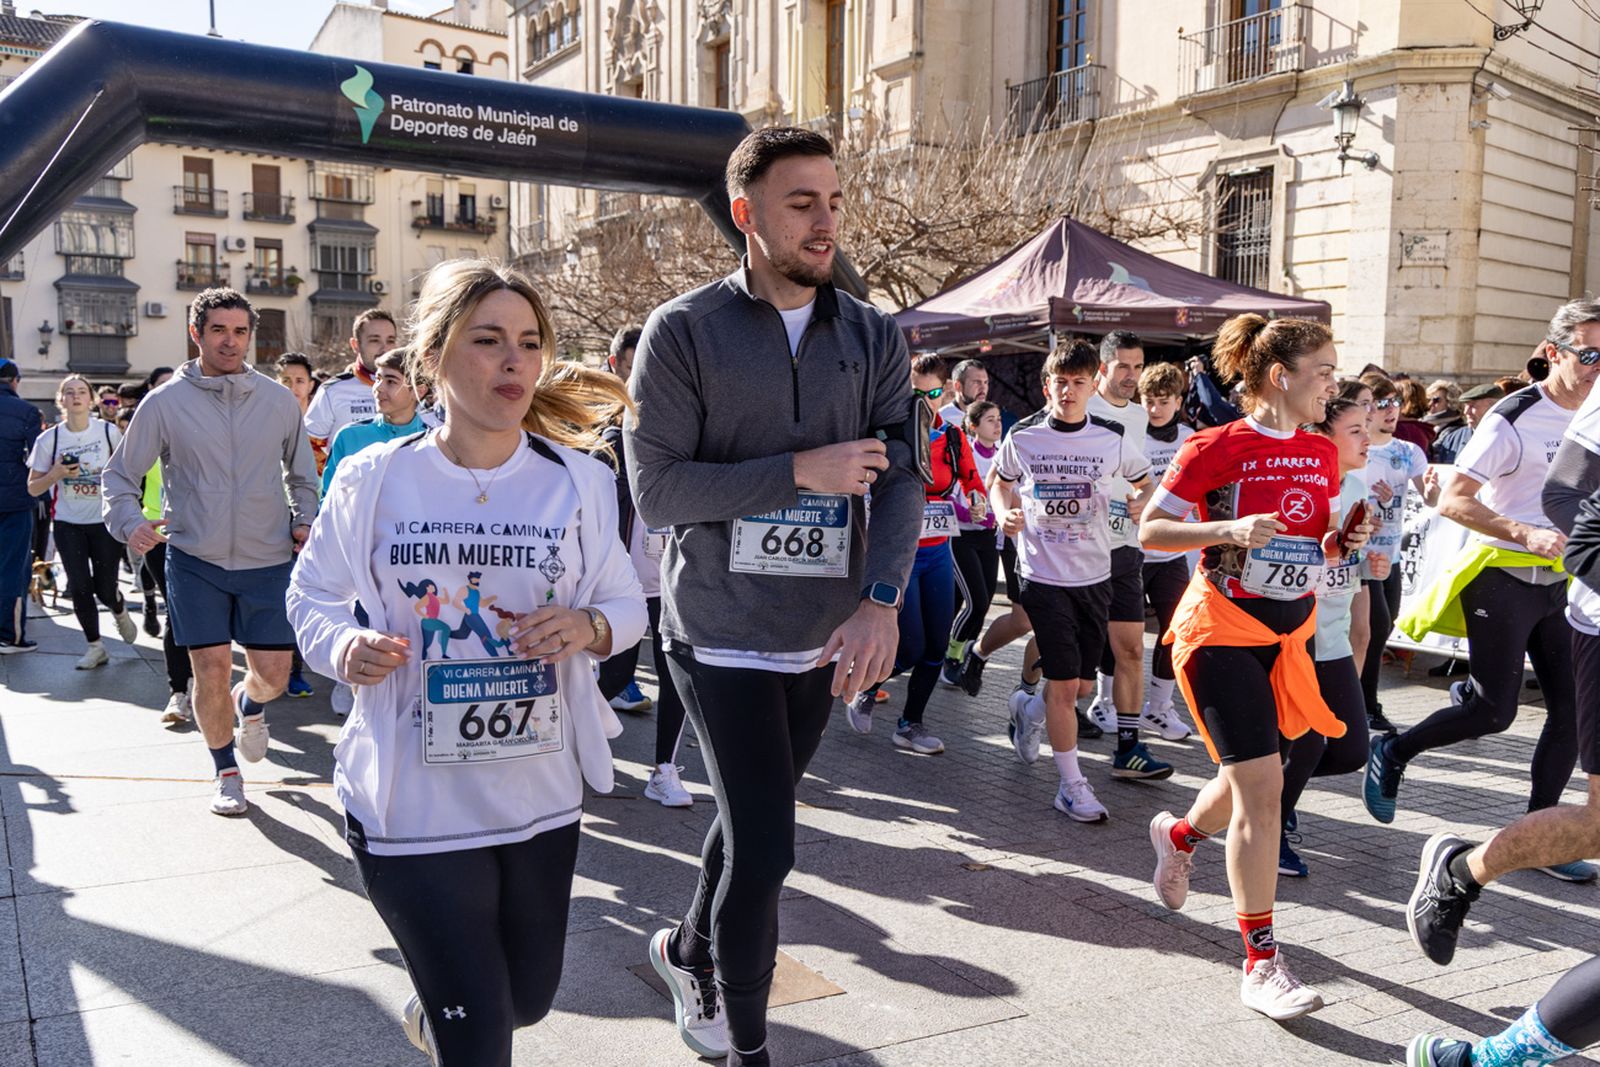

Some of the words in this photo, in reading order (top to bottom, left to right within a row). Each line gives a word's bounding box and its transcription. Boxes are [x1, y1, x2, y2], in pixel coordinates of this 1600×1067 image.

[390, 94, 473, 119] Patronato
[477, 105, 554, 130] Municipal
[558, 117, 579, 132] de
[390, 114, 468, 138] Deportes
[472, 125, 494, 141] de
[497, 128, 537, 146] Jaén
[350, 406, 373, 414] BUENA
[1069, 455, 1104, 464] CAMINATA
[1242, 460, 1257, 472] IX
[1266, 457, 1321, 469] CARRERA
[1030, 464, 1054, 475] BUENA
[1056, 464, 1088, 476] MUERTE
[73, 485, 97, 496] 902
[801, 498, 839, 508] CAMINATA
[1045, 499, 1080, 516] 660
[785, 509, 822, 523] MUERTE
[923, 516, 949, 529] 782
[395, 522, 405, 535] VI
[409, 521, 486, 535] CARRERA
[761, 525, 824, 557] 668
[389, 543, 450, 566] BUENA
[458, 543, 536, 569] MUERTE
[1260, 549, 1284, 560] BUENA
[1285, 551, 1310, 562] MUERTE
[1265, 563, 1308, 588] 786
[1326, 567, 1350, 587] 351
[443, 669, 453, 679] VI
[455, 667, 501, 678] CARRERA
[503, 662, 545, 677] CAMINATA
[443, 683, 482, 699] BUENA
[485, 679, 529, 697] MUERTE
[459, 699, 536, 741] 667
[456, 741, 491, 749] MARGARITA
